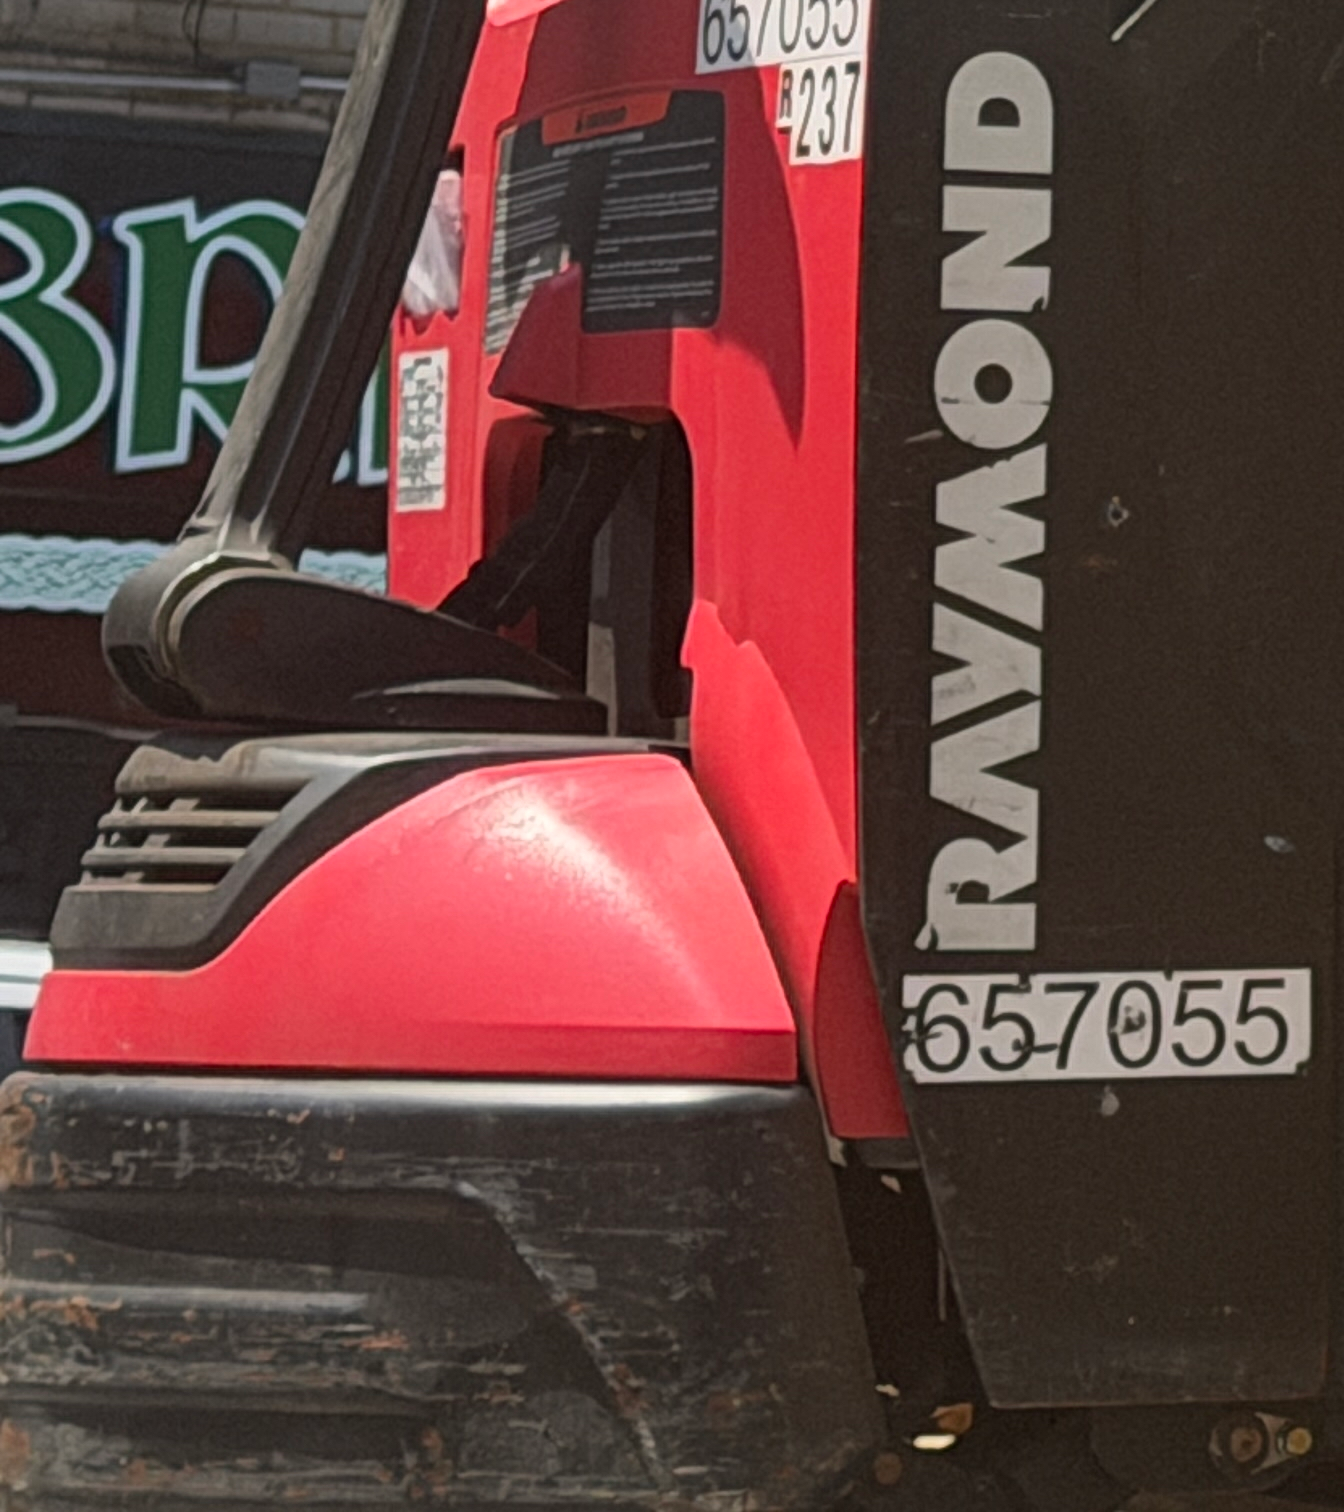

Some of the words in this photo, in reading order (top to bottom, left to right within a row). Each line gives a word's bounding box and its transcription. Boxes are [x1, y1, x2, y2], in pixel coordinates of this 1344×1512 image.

[795, 60, 862, 159] 237
[914, 50, 1055, 952] RAYMOND
[912, 978, 1291, 1076] 657055
